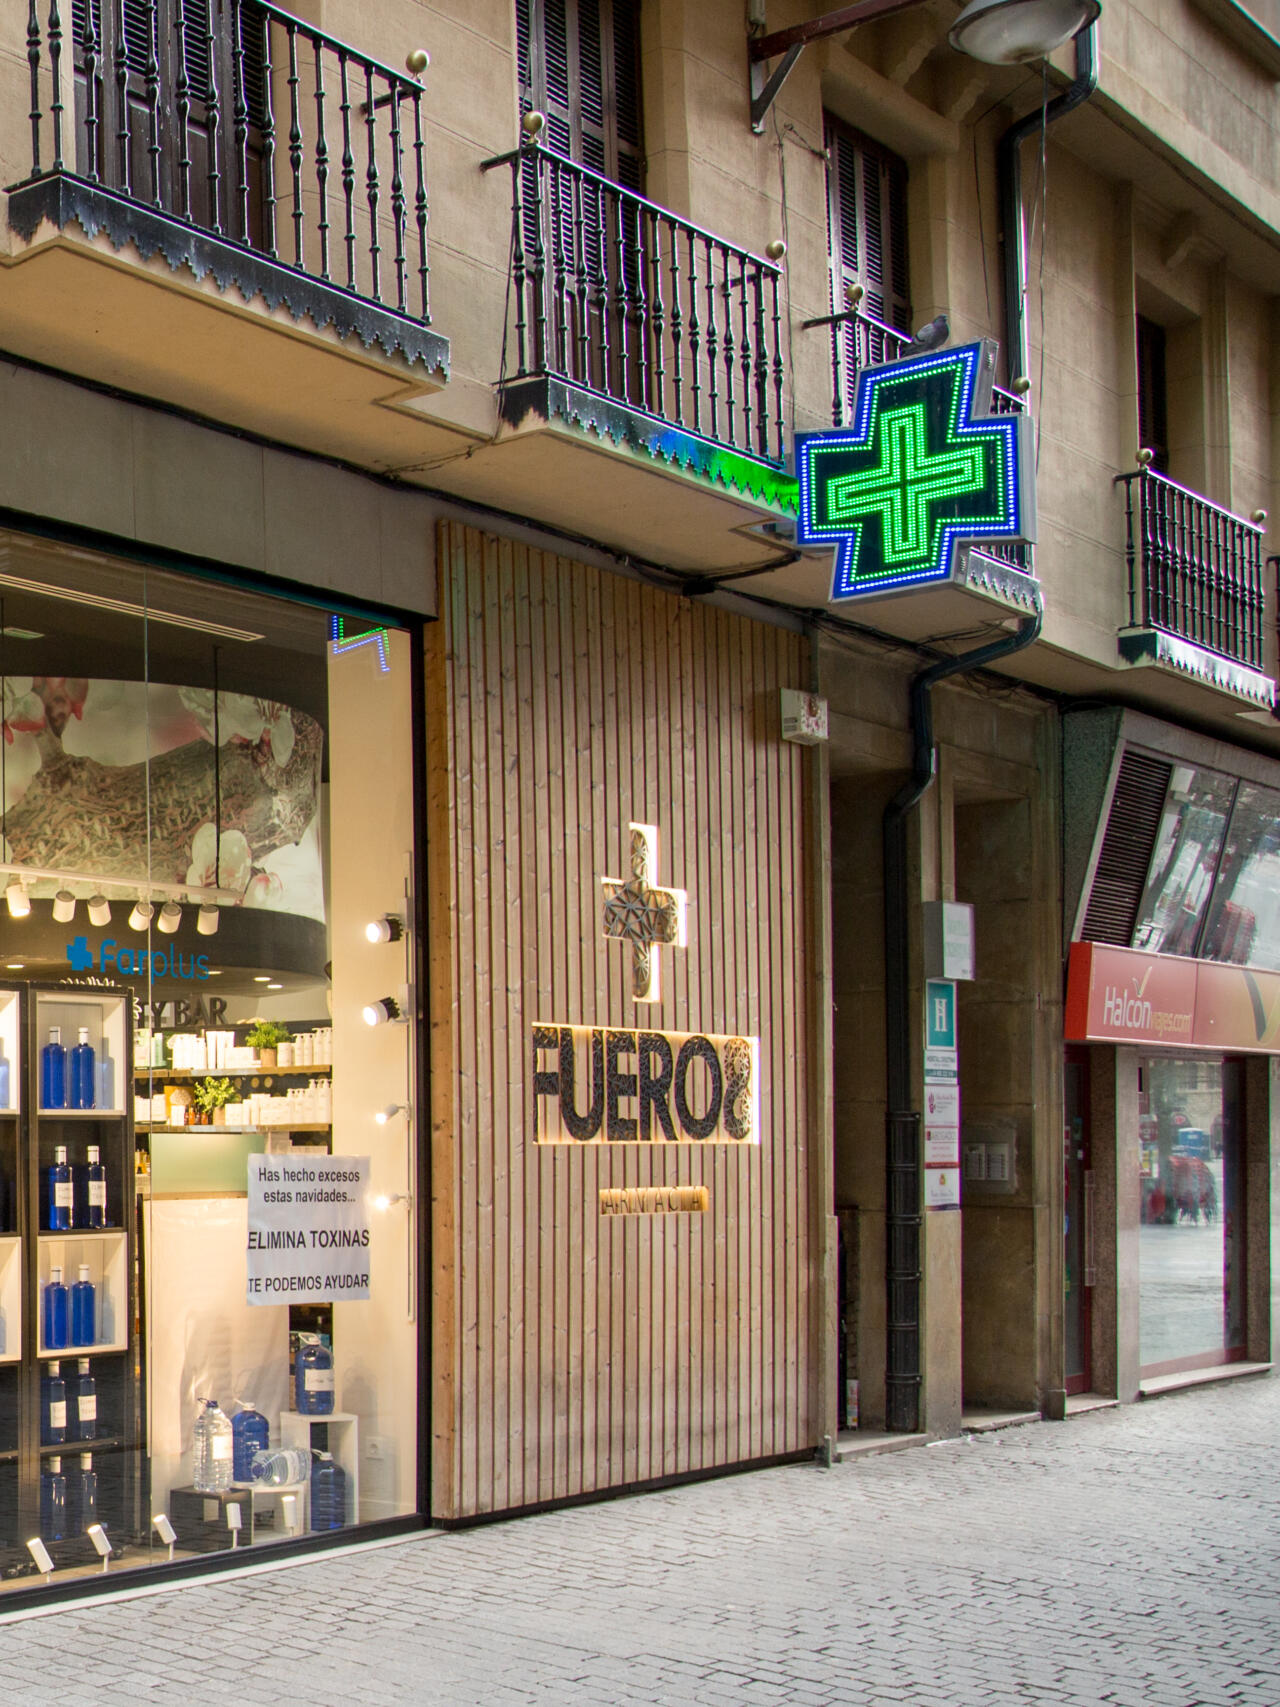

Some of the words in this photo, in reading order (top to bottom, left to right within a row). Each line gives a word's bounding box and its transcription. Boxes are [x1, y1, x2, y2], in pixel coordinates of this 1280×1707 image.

[533, 1026, 752, 1140] FUERO8
[258, 1167, 280, 1182] Has
[283, 1167, 315, 1182] hecho
[318, 1169, 360, 1183] excesos
[263, 1189, 292, 1203] estas
[295, 1188, 356, 1203] navidades...
[248, 1230, 306, 1250] ELIMINA
[310, 1229, 370, 1249] TOXINAS
[249, 1277, 262, 1292] TE
[265, 1275, 322, 1292] PODEMOS
[324, 1273, 369, 1289] AYUDAR
